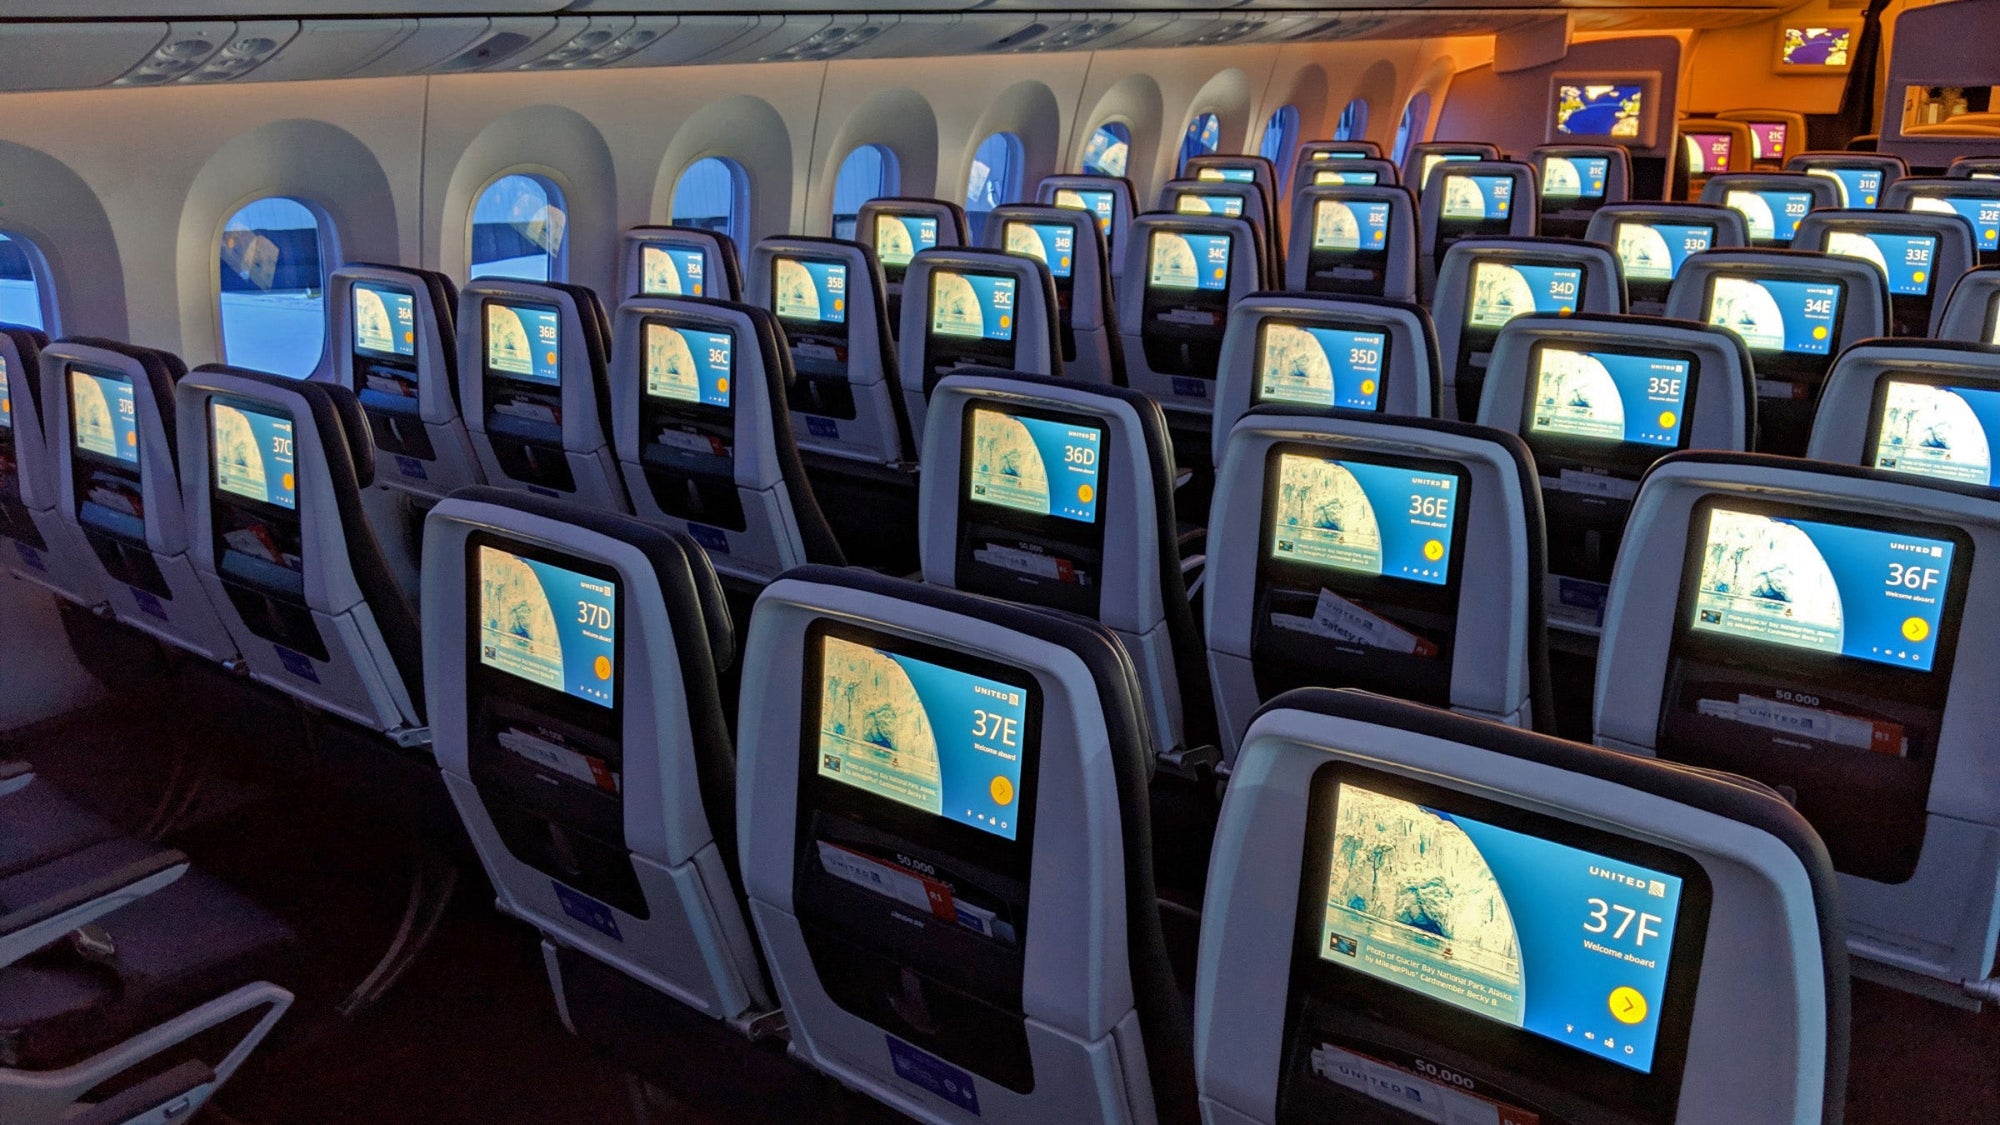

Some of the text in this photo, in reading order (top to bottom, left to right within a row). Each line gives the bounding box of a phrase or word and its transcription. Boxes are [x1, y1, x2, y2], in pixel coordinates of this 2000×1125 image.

[1858, 180, 1877, 189] 31D
[1784, 203, 1805, 213] 32D
[1978, 210, 1999, 221] 32E
[920, 229, 934, 240] 34A
[1684, 238, 1707, 250] 33D
[1207, 248, 1226, 259] 34C
[1905, 249, 1929, 261] 33E
[687, 263, 702, 275] 35A
[826, 276, 843, 289] 35B
[1549, 281, 1575, 295] 34D
[993, 291, 1012, 304] 35C
[397, 306, 413, 321] 36A
[1804, 299, 1832, 314] 34E
[538, 325, 556, 339] 36B
[709, 348, 728, 365] 36C
[1349, 348, 1378, 365] 35D
[1648, 377, 1681, 396] 35E
[119, 398, 134, 415] 37B
[272, 437, 292, 456] 37C
[1064, 445, 1095, 466] 36D
[1411, 477, 1441, 487] UNITED
[1409, 494, 1449, 518] 36E
[1890, 542, 1930, 554] UNITED
[1885, 562, 1940, 590] 36F
[580, 581, 604, 593] UNITED
[577, 601, 611, 629] 37D
[1321, 617, 1356, 641] Safety
[974, 685, 1008, 700] UNITED
[972, 709, 1018, 747] 37E
[1588, 865, 1646, 889] UNITED
[1583, 897, 1662, 947] 37F
[1583, 939, 1656, 969] Welcome aboard
[1366, 945, 1386, 958] Photo
[1386, 952, 1395, 960] of
[1395, 955, 1420, 969] Glacier
[1421, 964, 1436, 975] Bay
[1437, 969, 1467, 985] National
[1365, 955, 1373, 964] by
[1420, 973, 1465, 994] Cardmember
[1467, 989, 1489, 1004] Becky
[1339, 1065, 1402, 1093] UNITED
